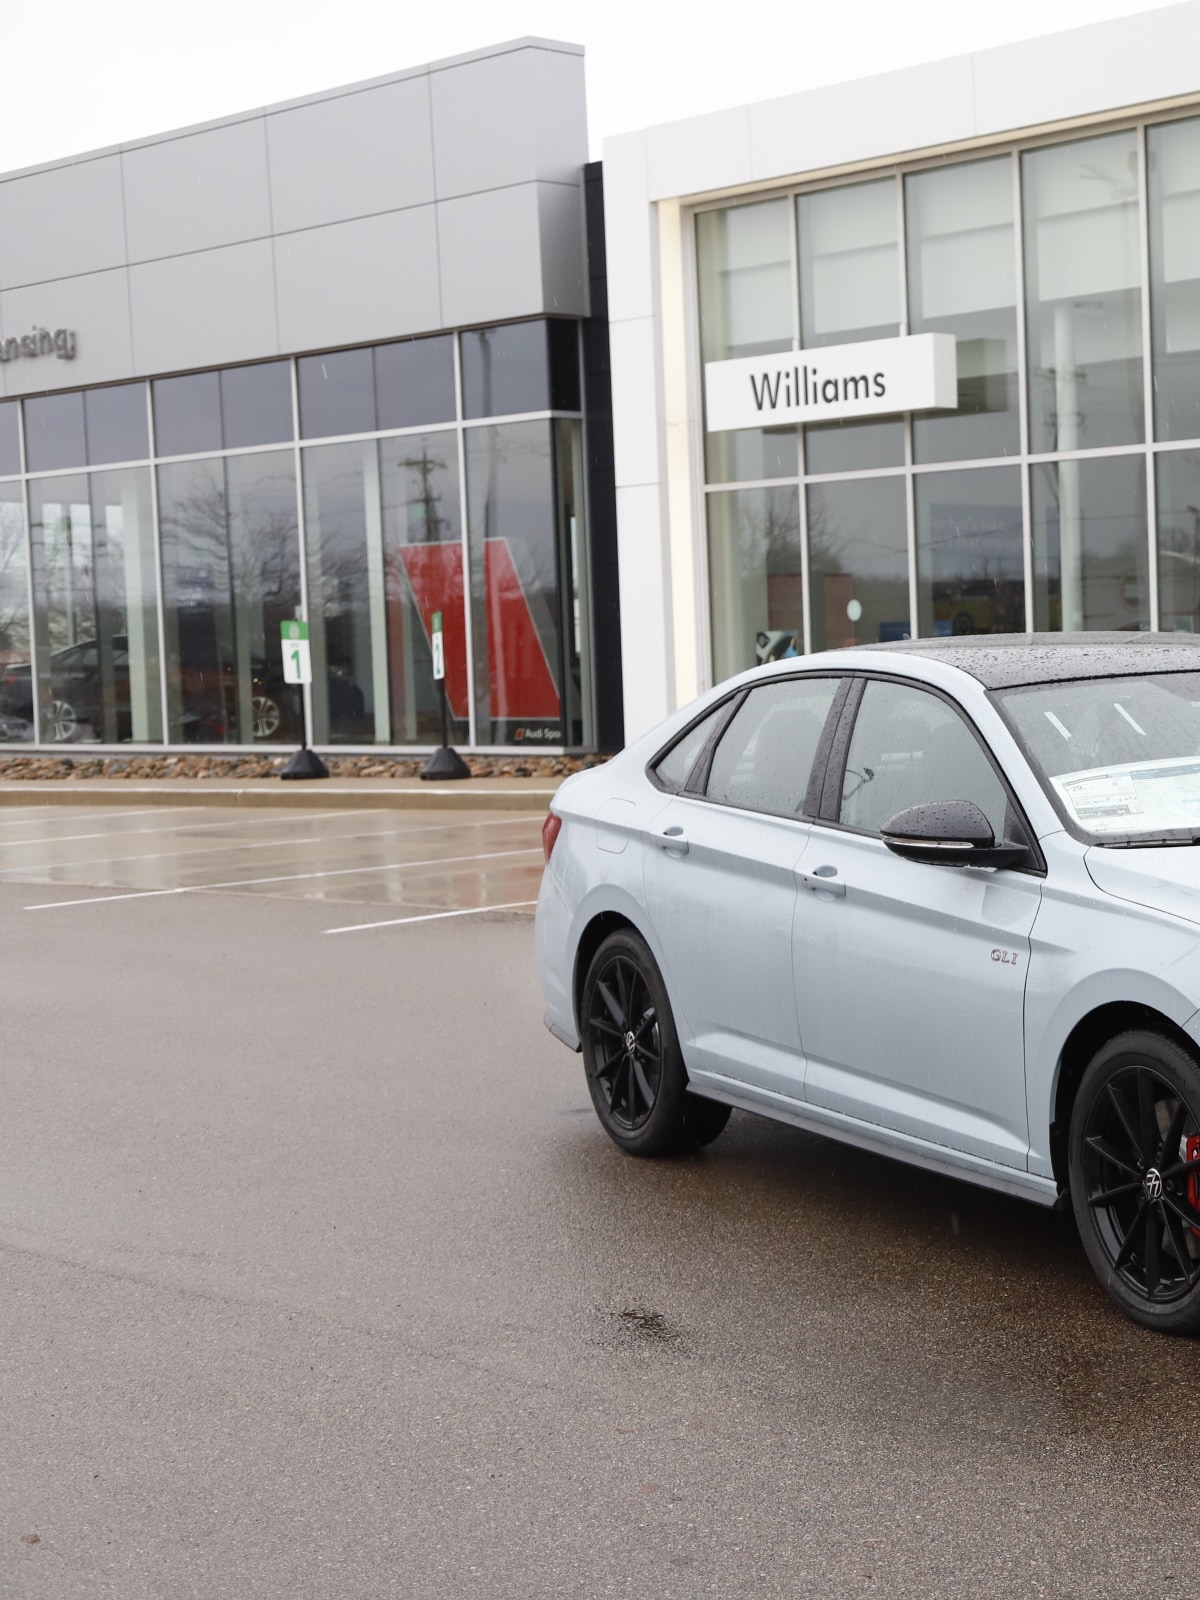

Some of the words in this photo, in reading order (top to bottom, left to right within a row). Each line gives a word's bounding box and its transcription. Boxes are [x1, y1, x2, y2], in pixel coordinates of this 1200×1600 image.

[0, 325, 77, 361] nsing
[750, 365, 886, 411] Williams
[291, 650, 301, 680] 1
[435, 642, 441, 675] 2
[525, 728, 542, 738] Audi
[991, 949, 1018, 965] GLI
